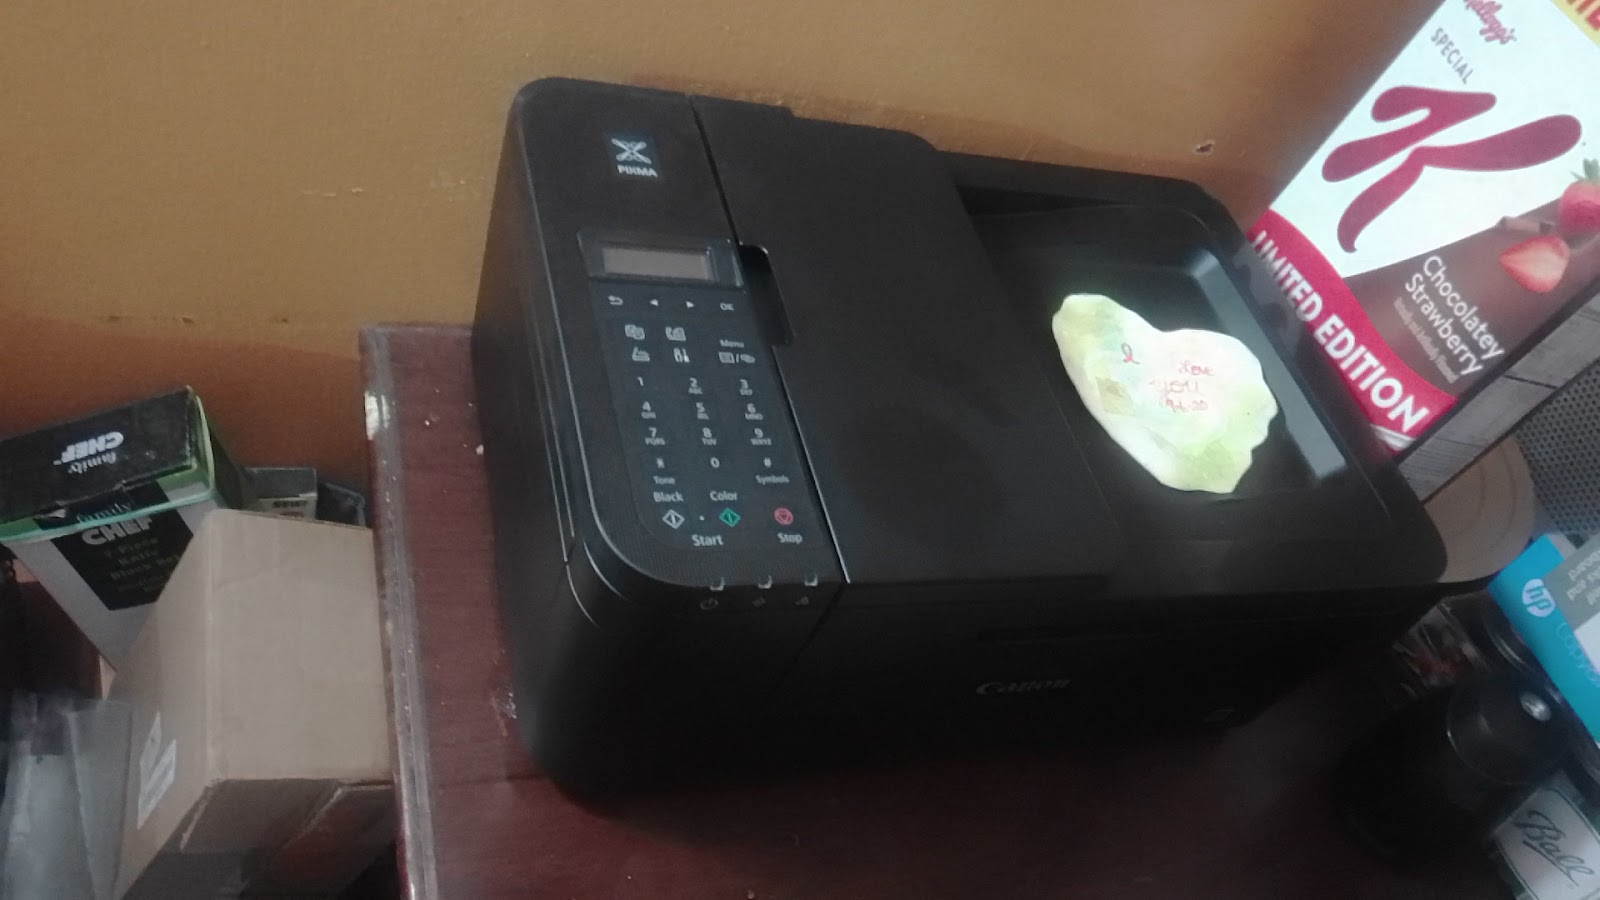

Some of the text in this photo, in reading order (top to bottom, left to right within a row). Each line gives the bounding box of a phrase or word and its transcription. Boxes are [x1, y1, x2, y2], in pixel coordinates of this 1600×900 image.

[1431, 27, 1474, 85] SPECIAL
[617, 165, 658, 178] PIXMA
[1322, 85, 1582, 254] K
[720, 303, 734, 311] OK
[1423, 256, 1504, 359] Chocolatey
[1405, 273, 1483, 375] Strawberry
[720, 339, 744, 348] Menu
[1314, 313, 1430, 433] EDITION
[637, 376, 644, 386] 1
[690, 377, 698, 387] 2
[739, 379, 748, 389] 3
[642, 401, 651, 411] 4
[696, 402, 705, 412] 5
[747, 403, 756, 413] 6
[649, 426, 657, 437] 7
[702, 427, 712, 438] 8
[754, 427, 763, 438] 9
[61, 431, 124, 463] CHEF
[710, 457, 720, 468] 0
[653, 475, 676, 485] Tone
[755, 474, 790, 485] Symbols
[653, 490, 738, 502] Black Color
[691, 534, 724, 546] Start
[778, 532, 803, 544] Stop
[1514, 810, 1595, 886] Ball
